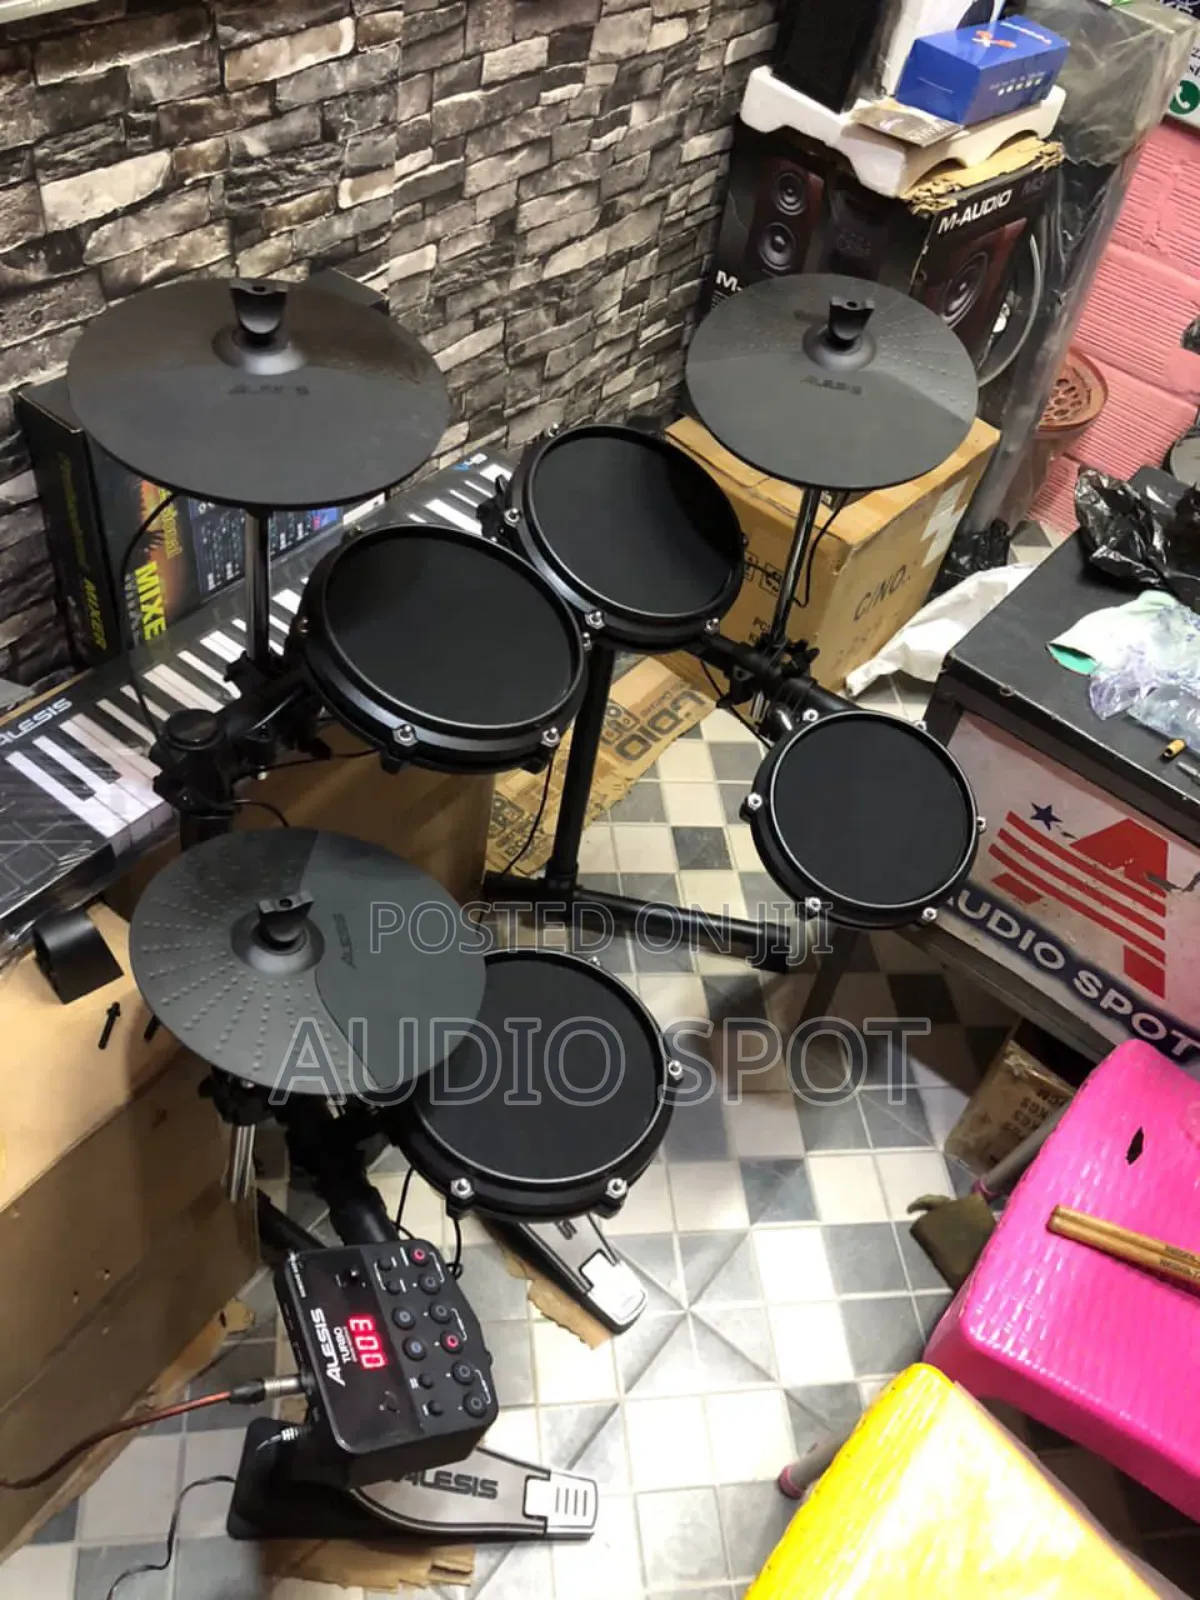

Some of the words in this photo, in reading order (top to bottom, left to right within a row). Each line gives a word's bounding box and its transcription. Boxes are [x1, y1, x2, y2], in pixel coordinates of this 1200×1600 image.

[937, 189, 1014, 235] M-AUDIO
[946, 888, 1066, 970] UDIO
[1072, 969, 1200, 1057] SPOT
[309, 1307, 346, 1387] ALESIS
[333, 1325, 352, 1363] TURBO
[349, 1317, 387, 1370] 003
